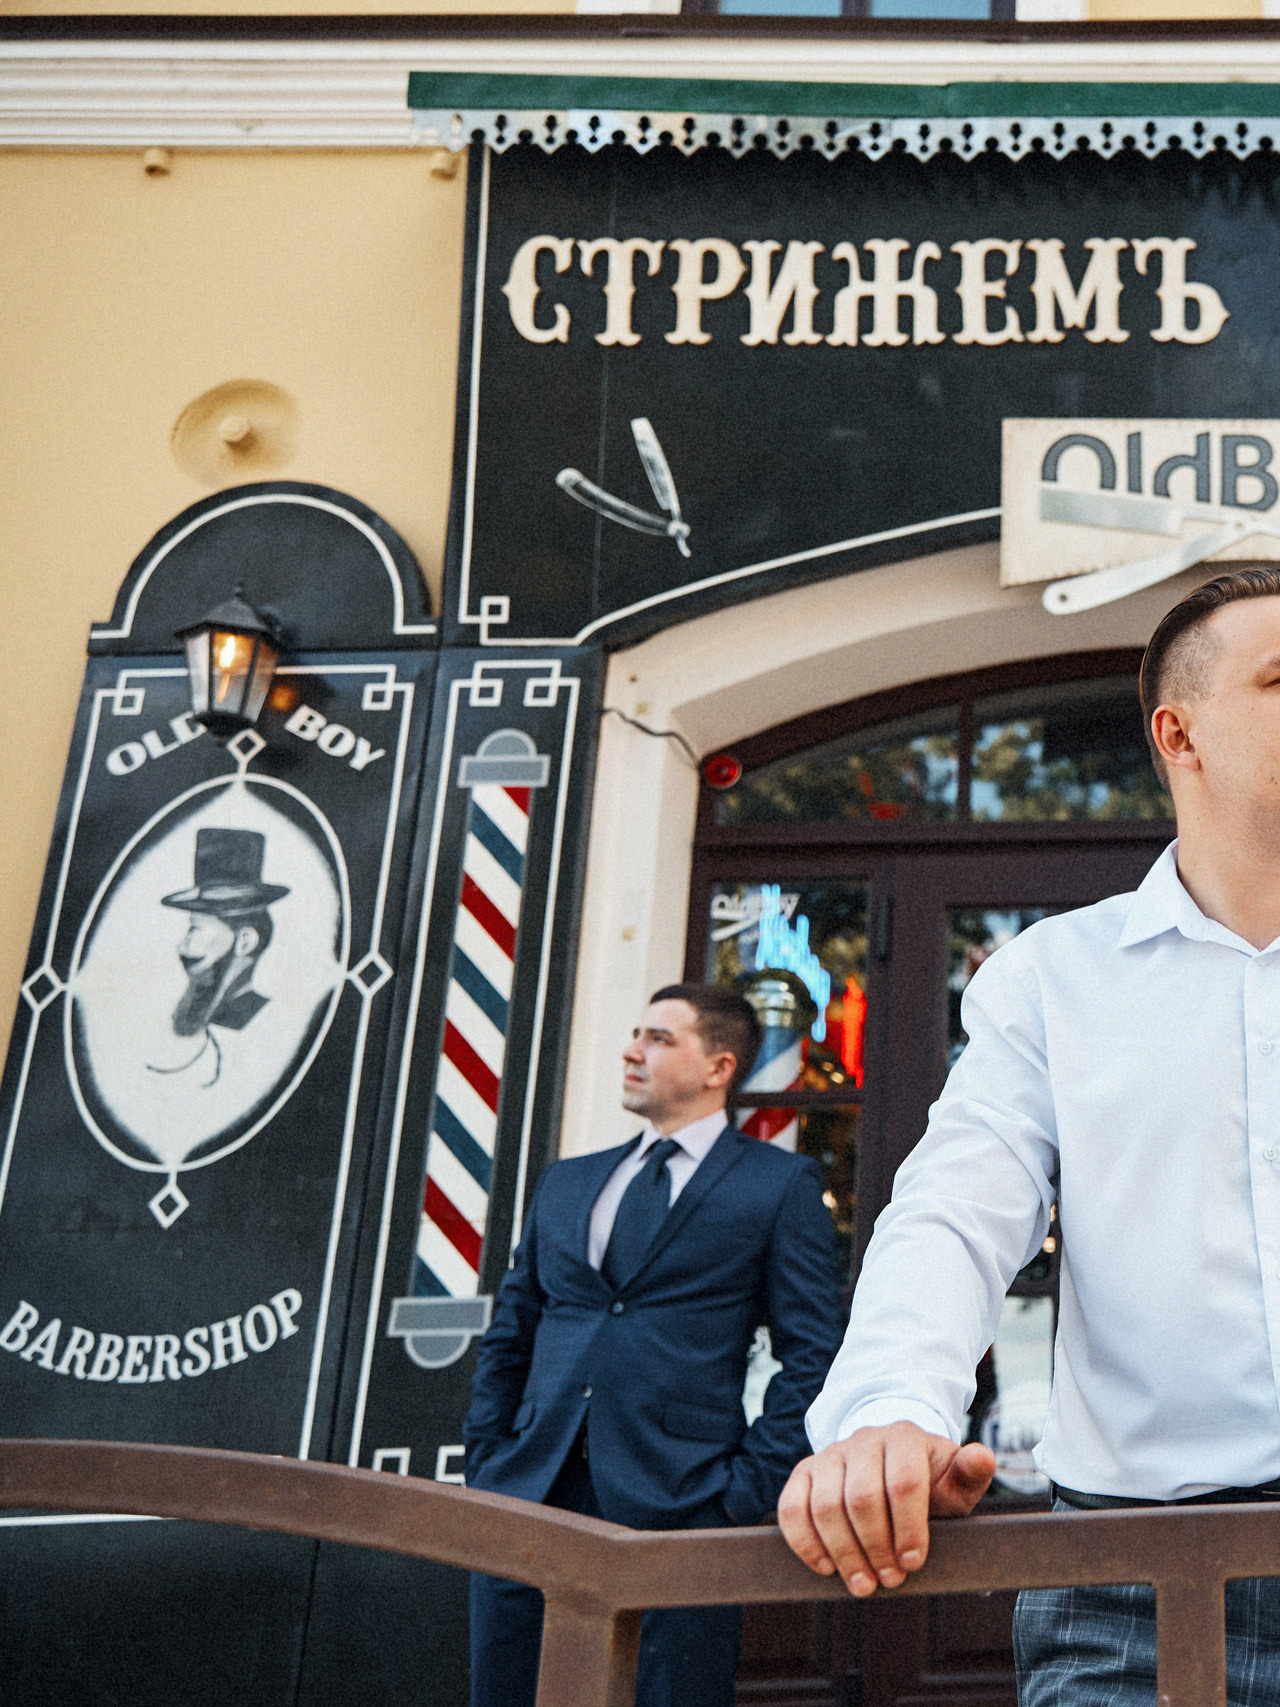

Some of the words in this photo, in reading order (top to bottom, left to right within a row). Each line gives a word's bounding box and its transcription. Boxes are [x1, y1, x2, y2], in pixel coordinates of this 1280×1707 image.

[502, 235, 1231, 347] СТРИЖЕМЪ
[284, 704, 386, 771] BOY
[0, 1287, 303, 1384] BARBERSHOP
